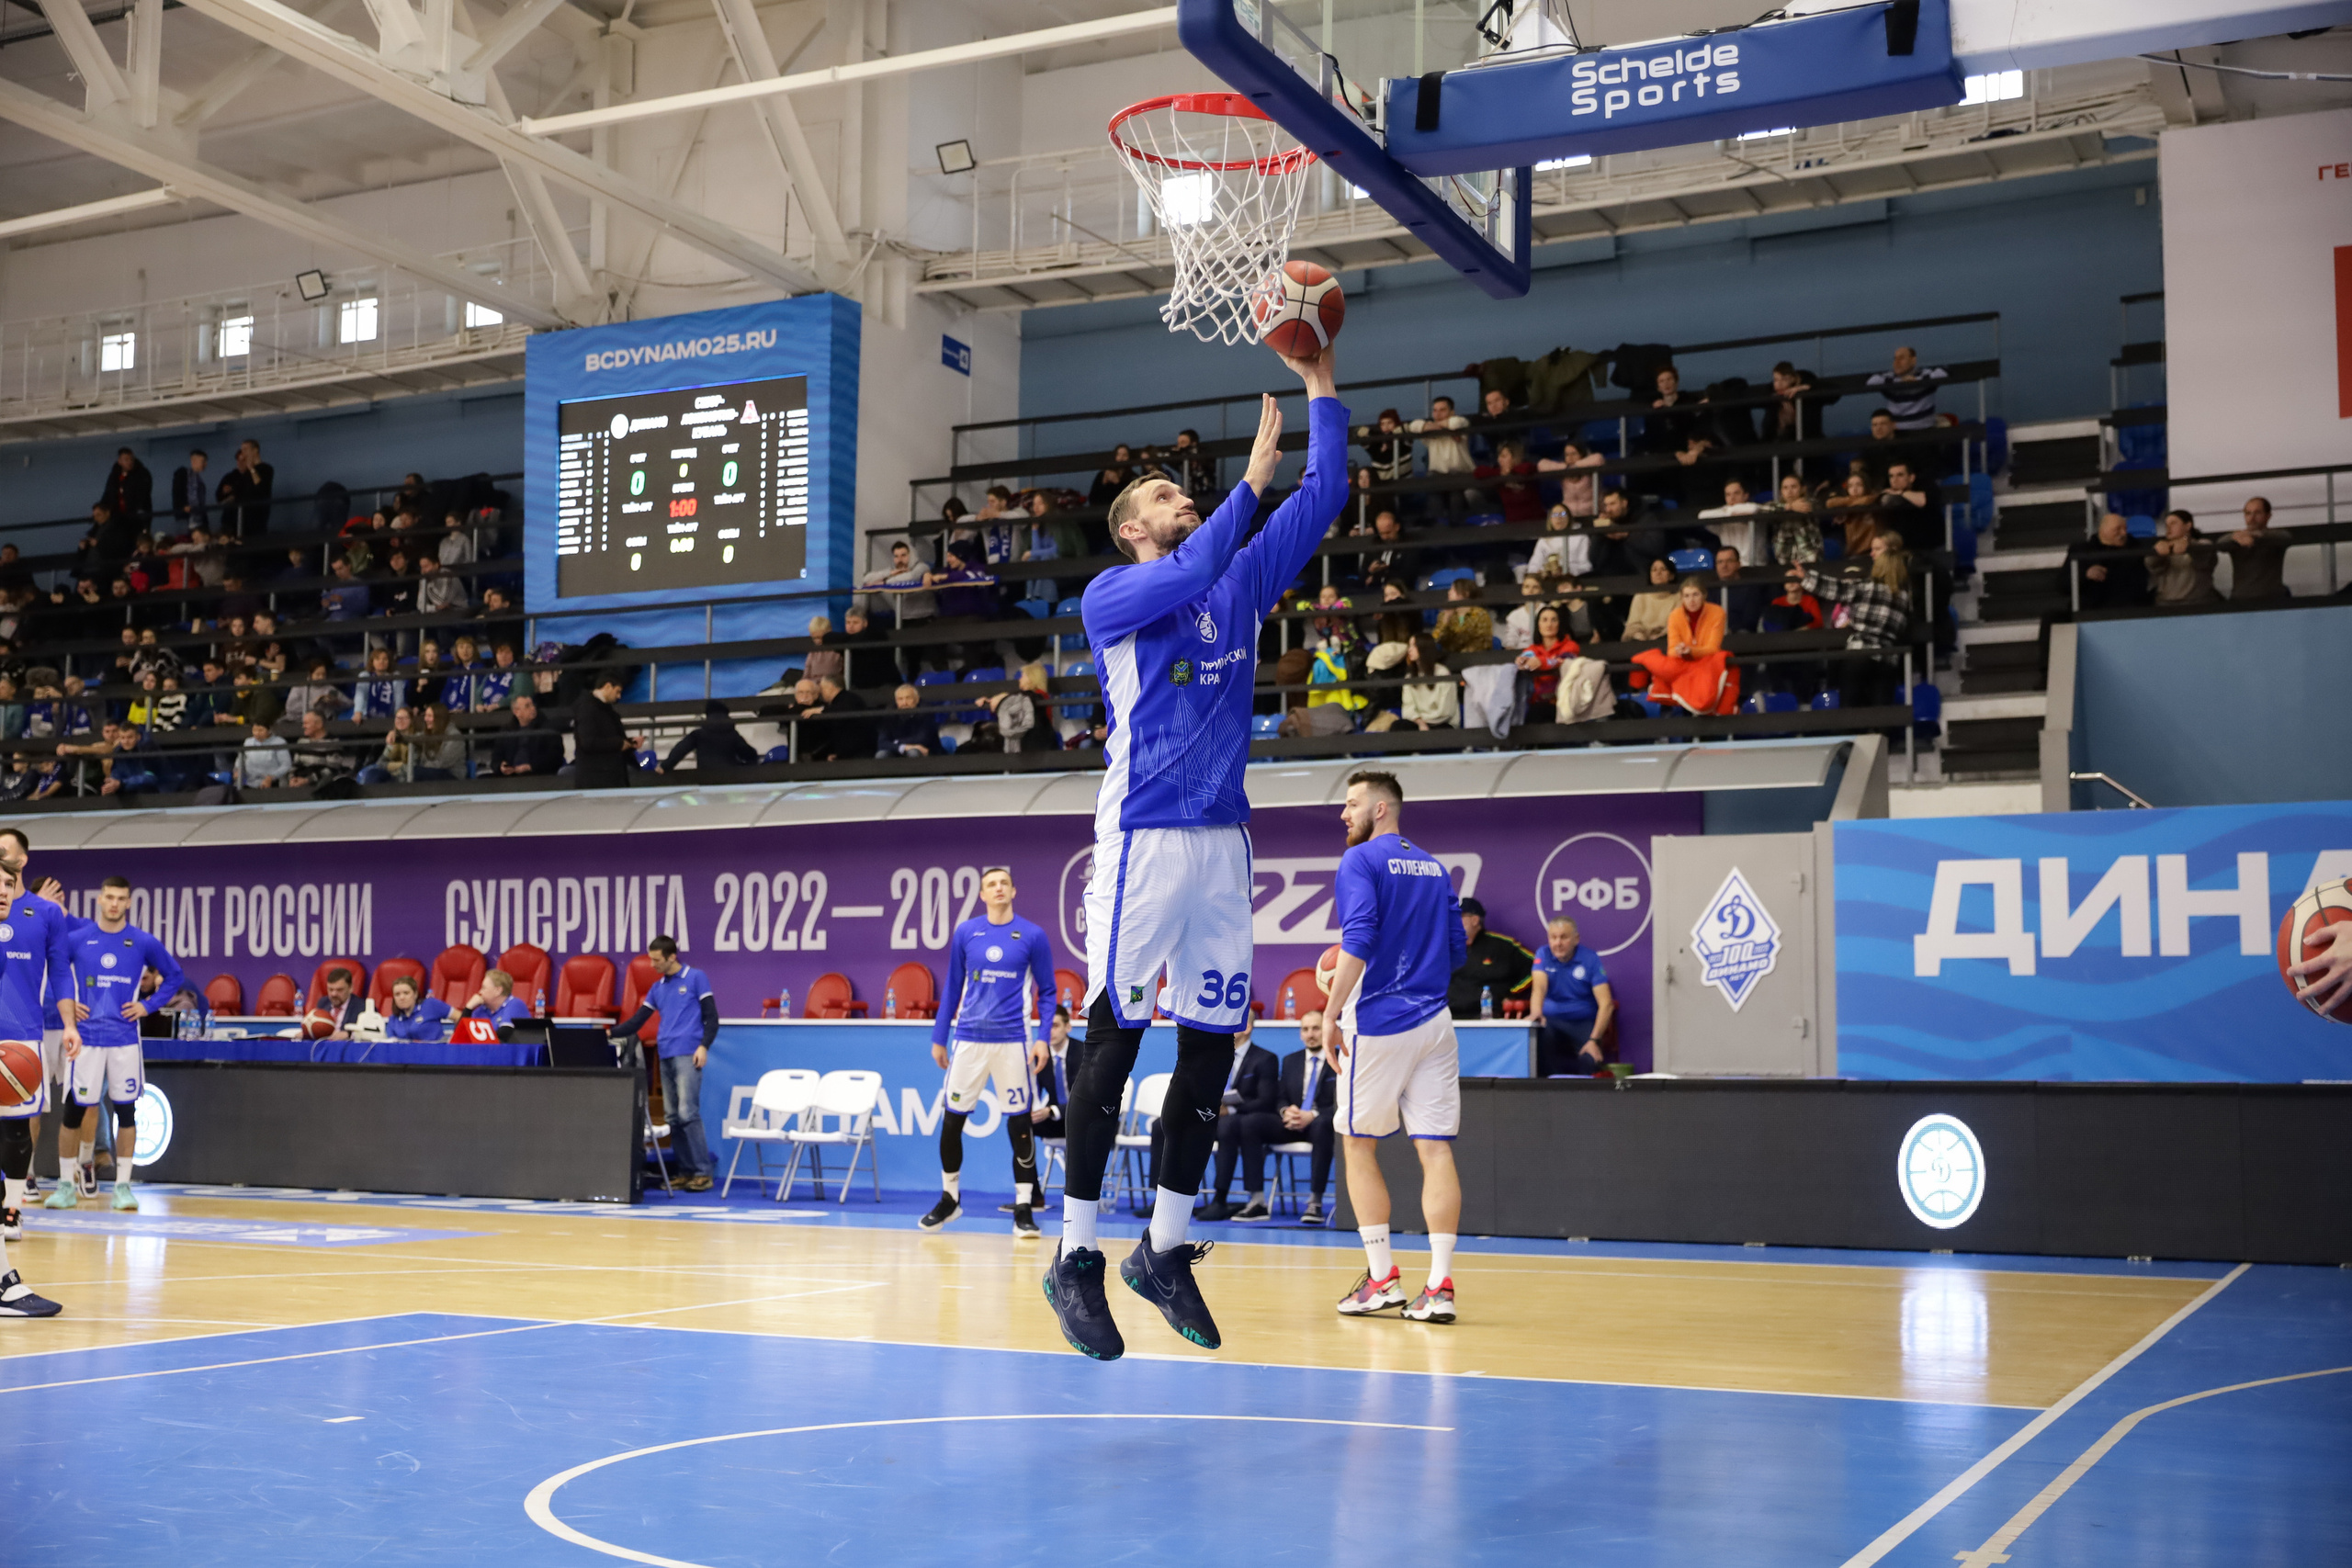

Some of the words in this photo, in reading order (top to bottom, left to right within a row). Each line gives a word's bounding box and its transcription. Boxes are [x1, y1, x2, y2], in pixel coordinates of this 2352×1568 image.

[1572, 44, 1739, 88] Schelde
[1572, 72, 1741, 118] Sports
[2318, 162, 2352, 181] ГЕ
[585, 329, 776, 372] BCDYNAMO25.RU
[630, 470, 646, 495] 0
[722, 460, 738, 487] 0
[1200, 673, 1221, 685] КРА
[1387, 858, 1442, 877] СТУЛЕНКОВ
[1551, 876, 1641, 911] РФБ
[224, 883, 372, 957] РОССИИ
[445, 874, 690, 954] СУПЕРЛИГА
[714, 865, 1010, 953] 2022—202
[1715, 941, 1762, 966] 100
[1708, 957, 1770, 980] ДИНАМО
[1197, 969, 1249, 1010] 36
[469, 1020, 496, 1041] 5
[125, 1078, 137, 1094] 3
[1007, 1088, 1025, 1104] 21
